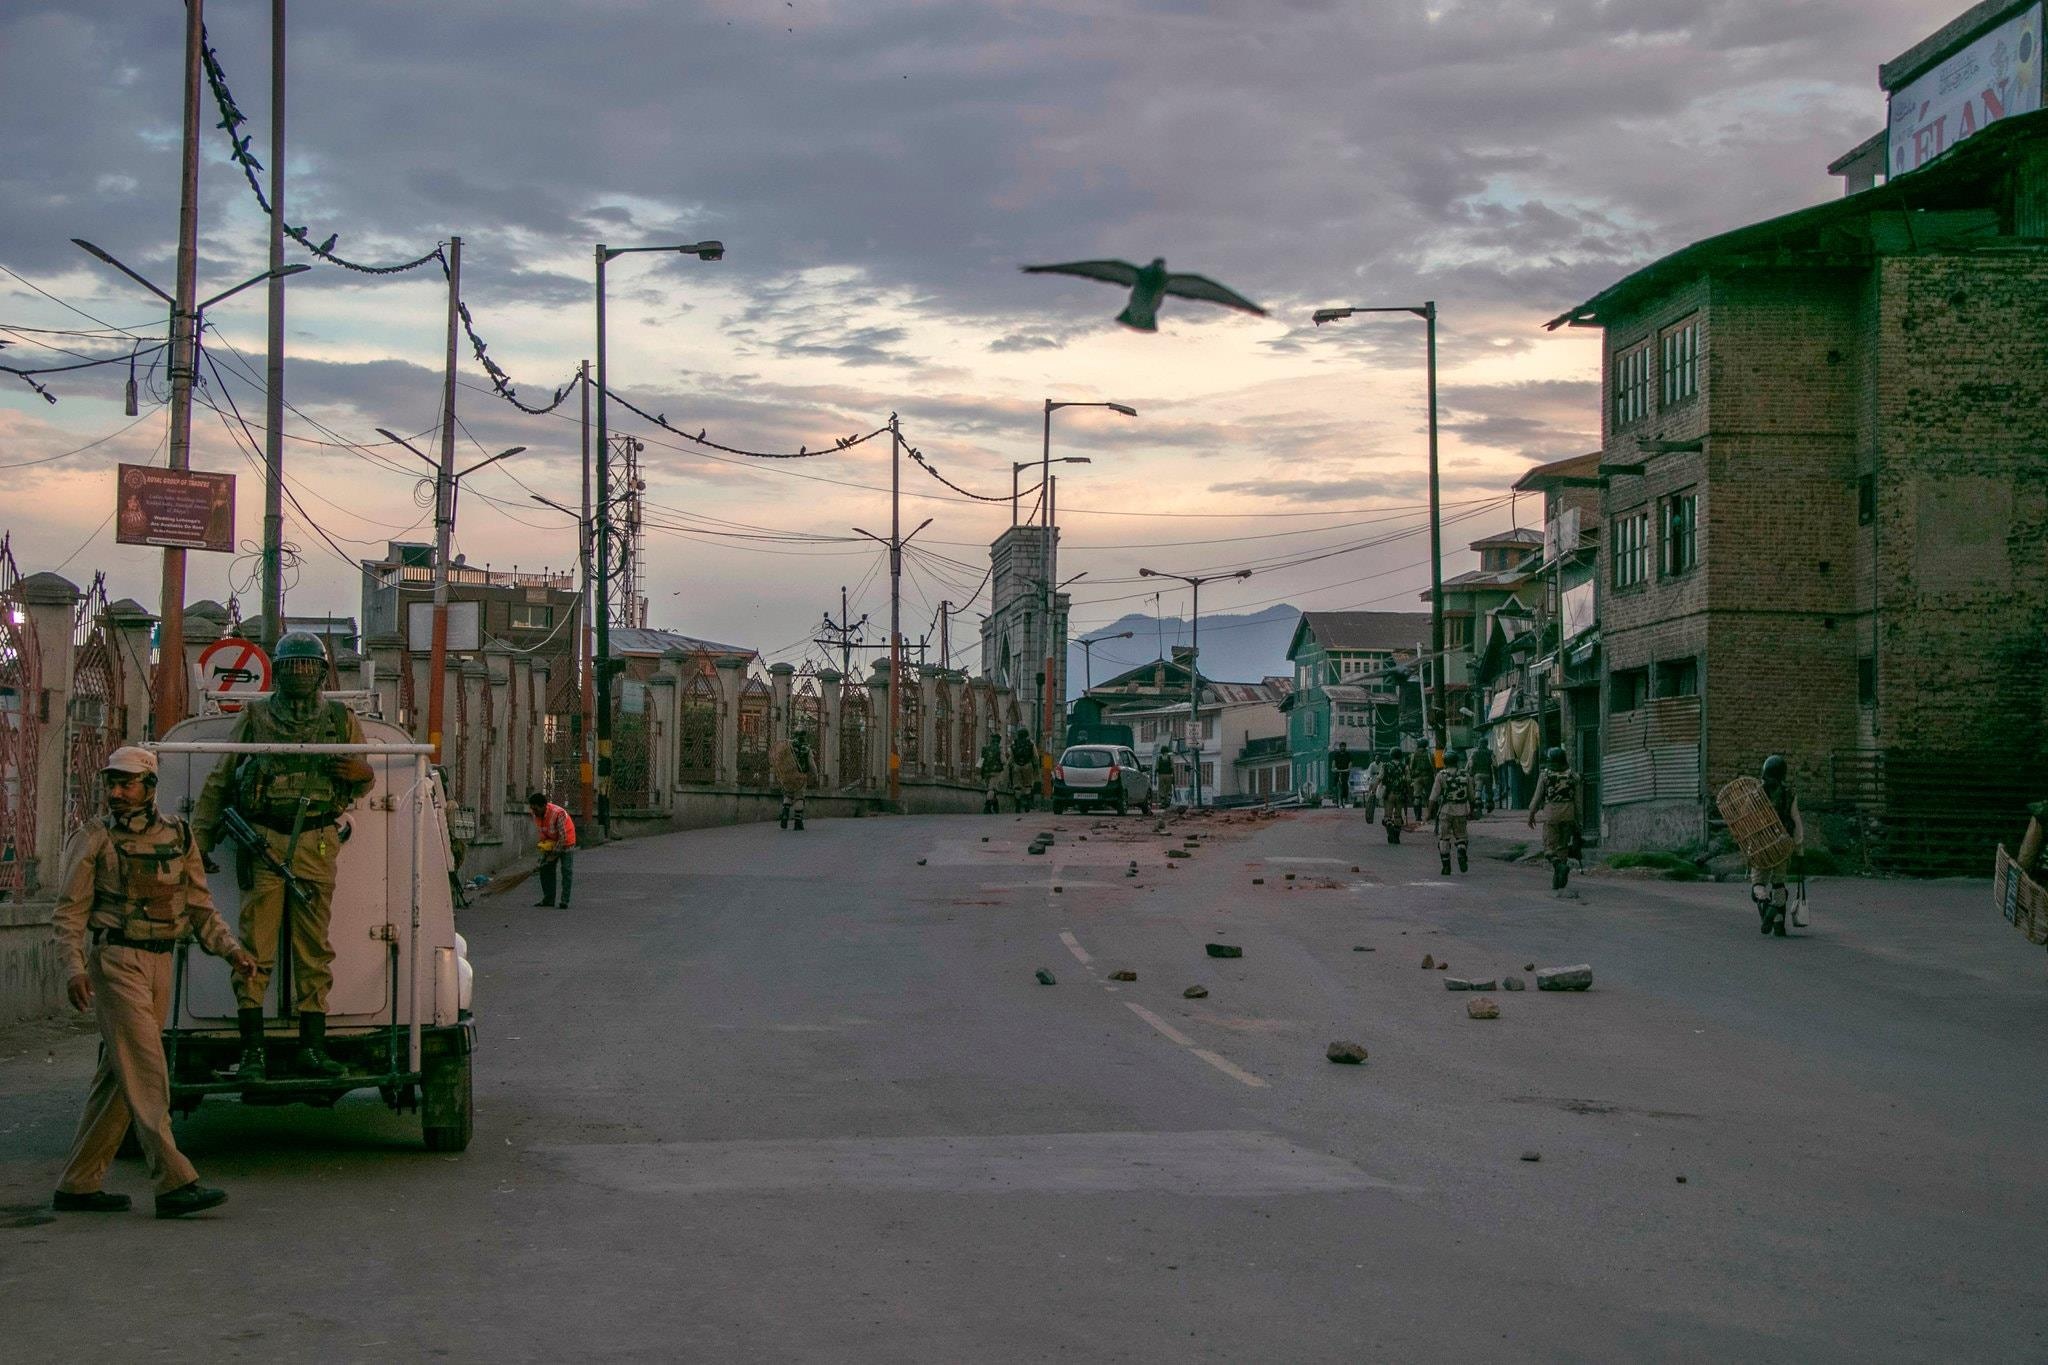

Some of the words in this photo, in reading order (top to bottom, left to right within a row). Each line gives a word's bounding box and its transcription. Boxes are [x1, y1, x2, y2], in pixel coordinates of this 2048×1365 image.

[147, 476, 162, 484] ROYAL
[163, 477, 180, 486] GROUP
[188, 479, 210, 489] TRADERS
